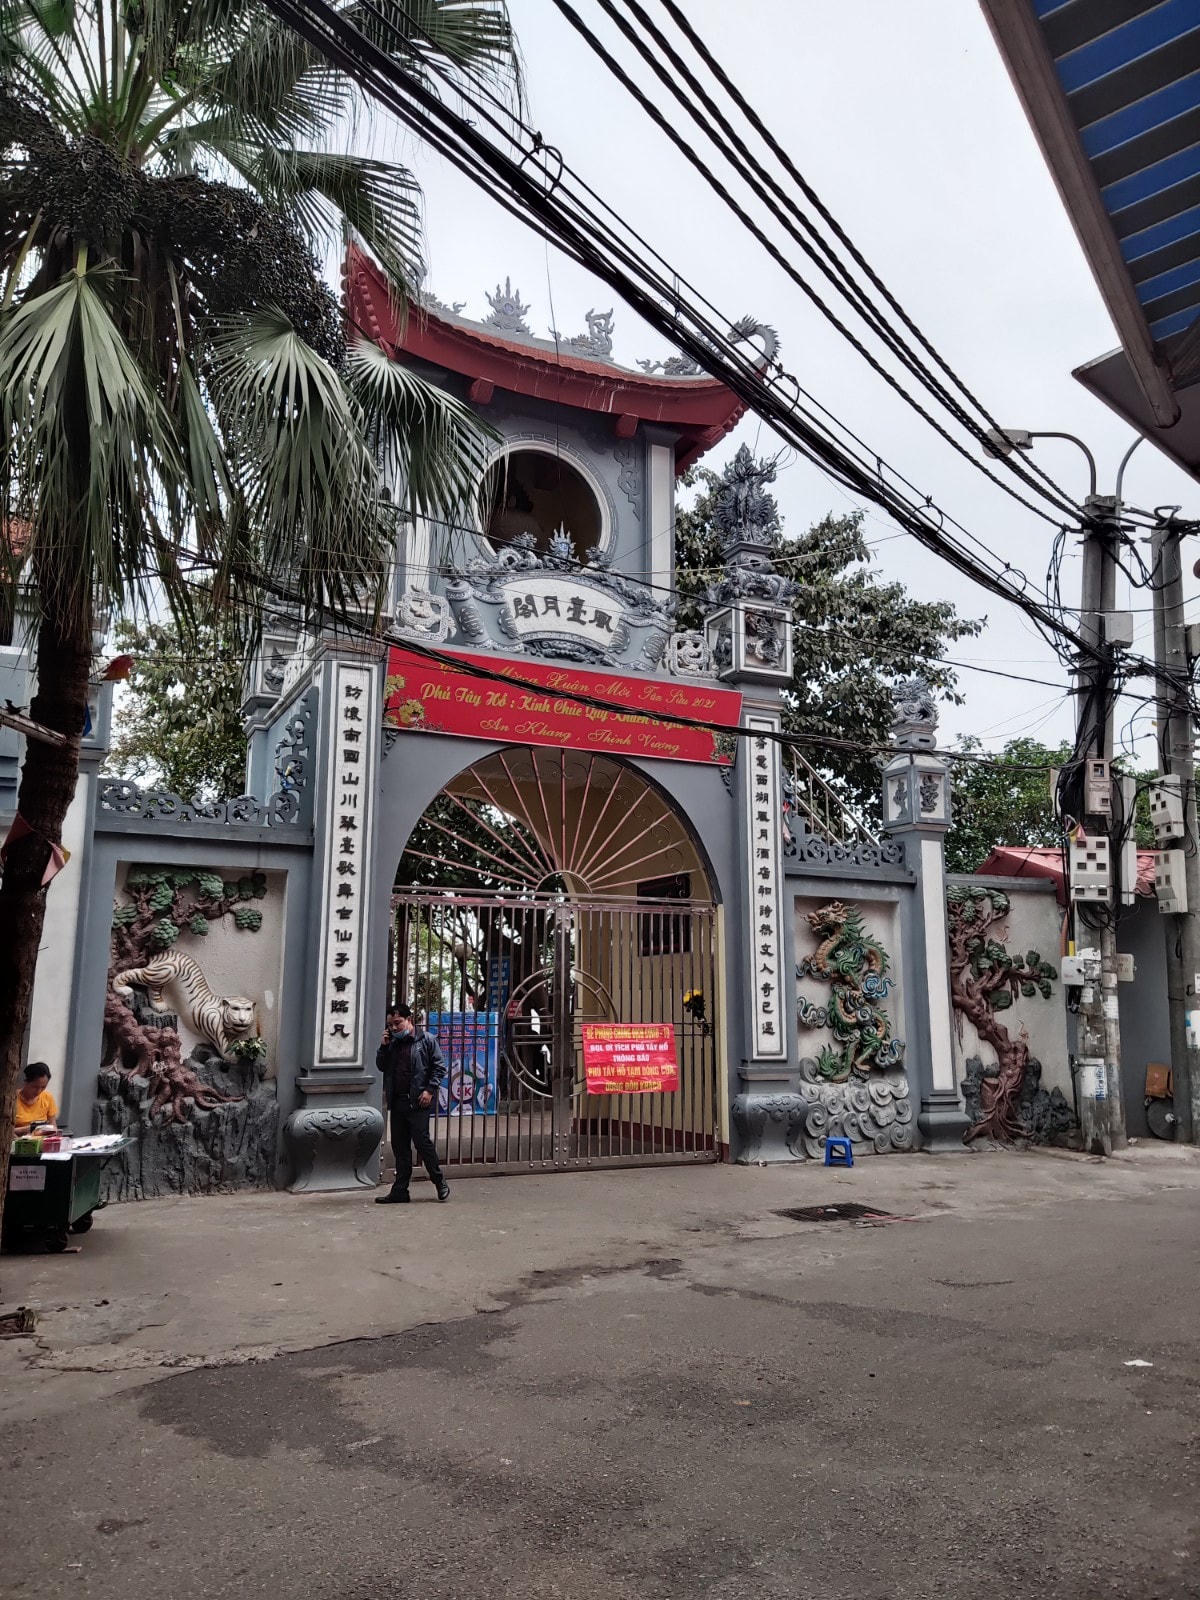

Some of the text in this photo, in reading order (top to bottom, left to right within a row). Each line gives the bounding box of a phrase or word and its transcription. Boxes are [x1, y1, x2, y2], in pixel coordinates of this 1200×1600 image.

[455, 687, 482, 706] Tây
[692, 697, 716, 708] 2021
[480, 717, 510, 732] An
[515, 720, 571, 744] Khang
[613, 1053, 650, 1062] THÔNG BÁO
[603, 1064, 615, 1076] TÂY
